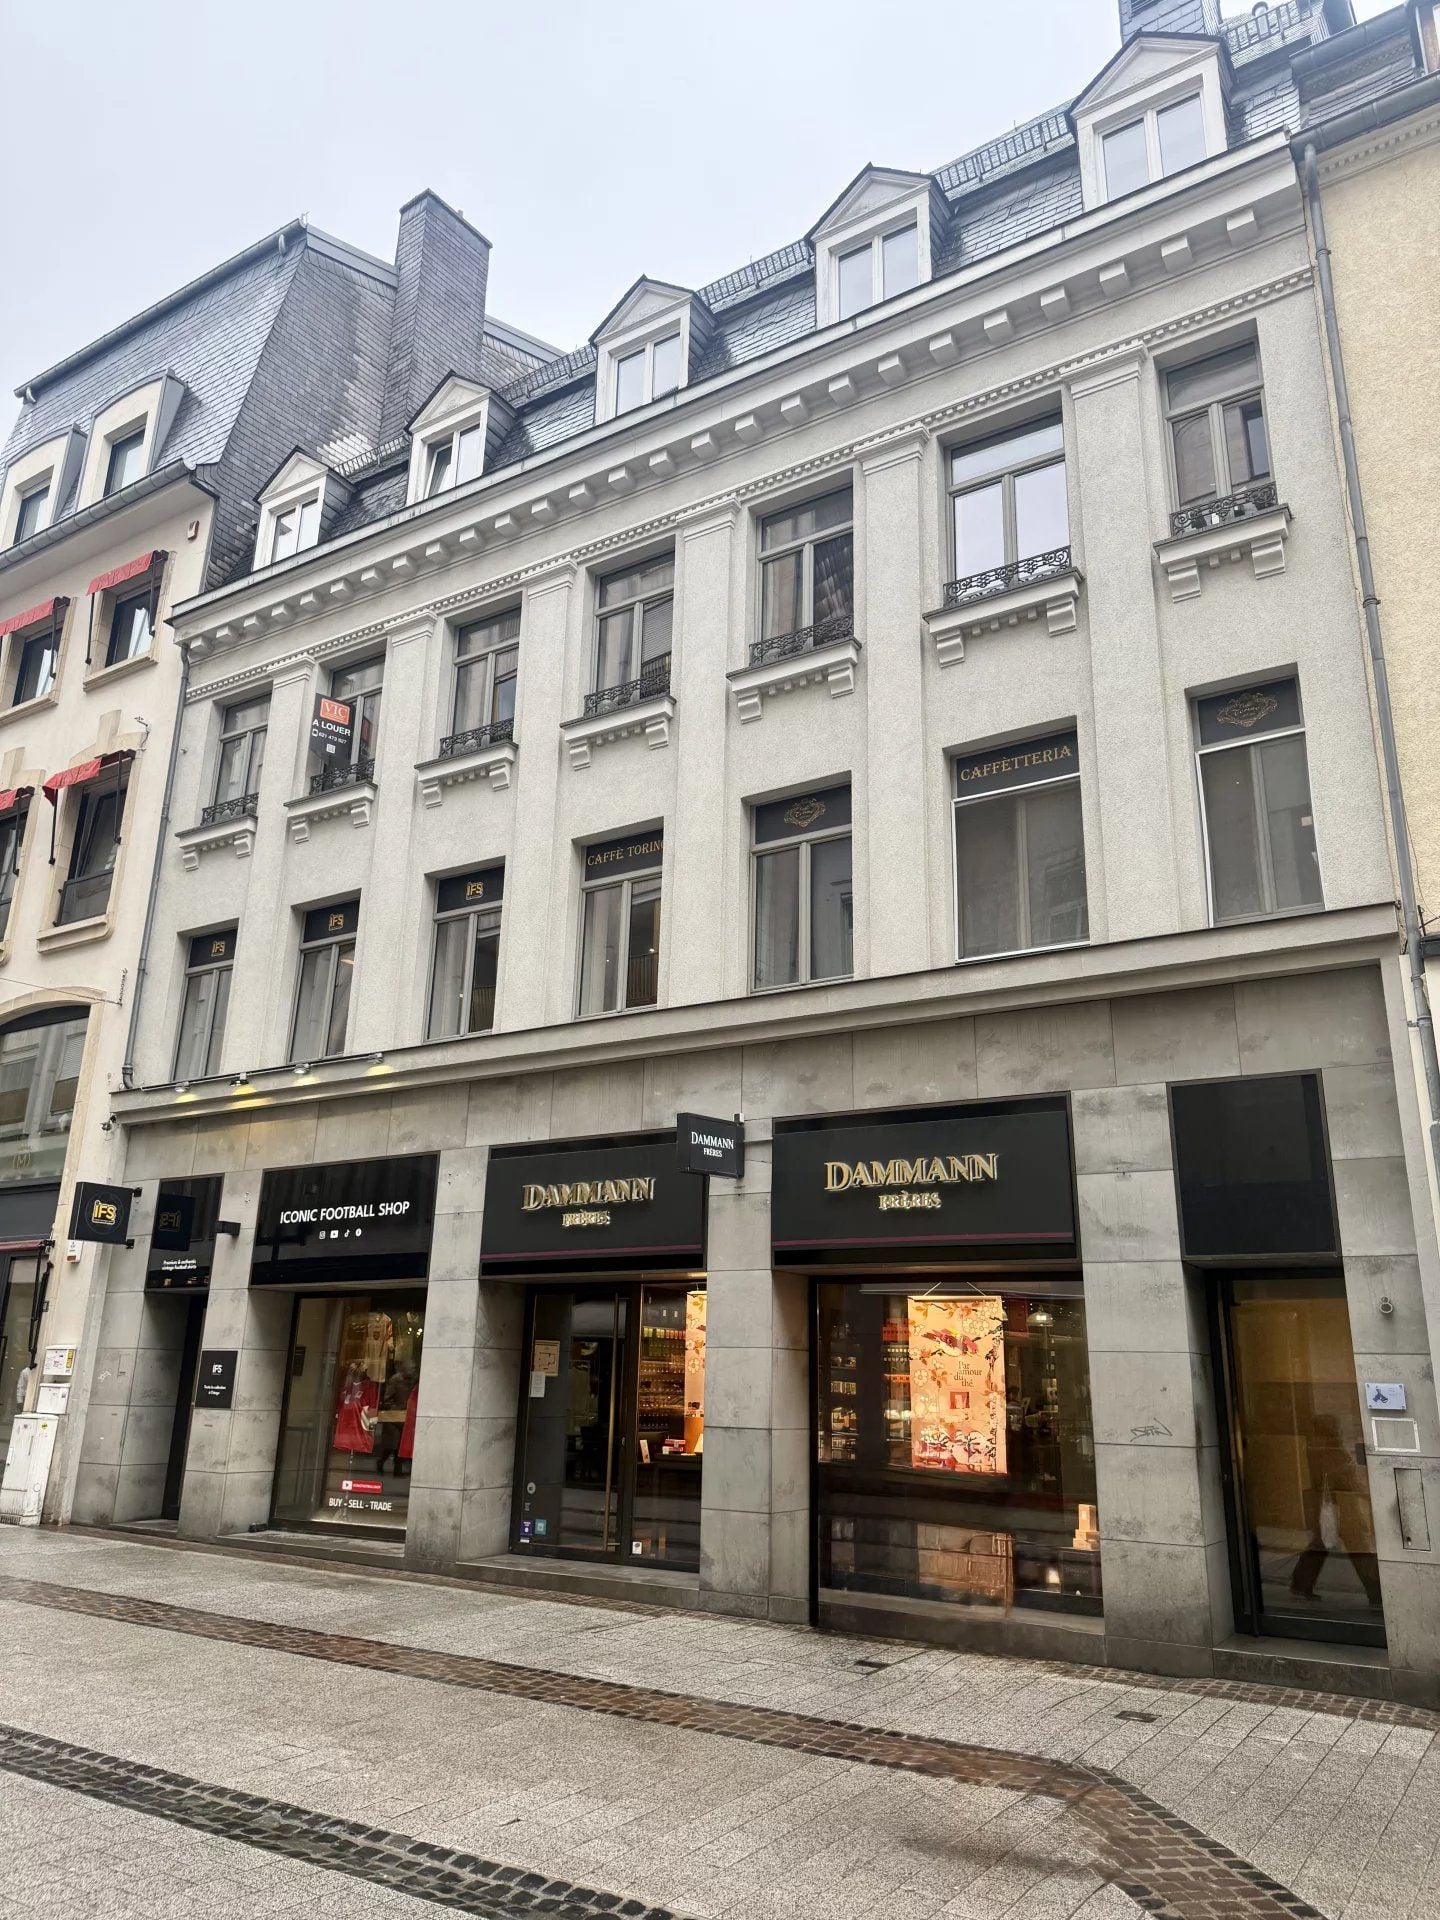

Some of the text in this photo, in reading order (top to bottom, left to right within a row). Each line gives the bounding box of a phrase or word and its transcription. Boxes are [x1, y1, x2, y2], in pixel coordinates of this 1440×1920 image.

[324, 702, 348, 717] VIC
[312, 719, 351, 737] A LOUER
[960, 745, 1073, 781] CAFFÈTTERIA
[587, 839, 664, 866] CAFFÈ TORIN
[691, 1131, 734, 1150] DAMMANN
[824, 1153, 999, 1192] DAMMANN
[521, 1176, 656, 1211] DAMMANN
[878, 1190, 942, 1211] FRÈRES
[93, 1202, 116, 1222] IFS
[280, 1201, 410, 1224] ICONIC FOOTBALL SHOP
[562, 1209, 612, 1227] FRÈRES
[1380, 1296, 1393, 1314] 8
[212, 1363, 223, 1373] IFS
[958, 1361, 971, 1370] Par
[953, 1371, 964, 1381] du
[329, 1498, 343, 1507] BUY
[348, 1500, 364, 1509] SELL
[370, 1501, 392, 1512] TRADE
